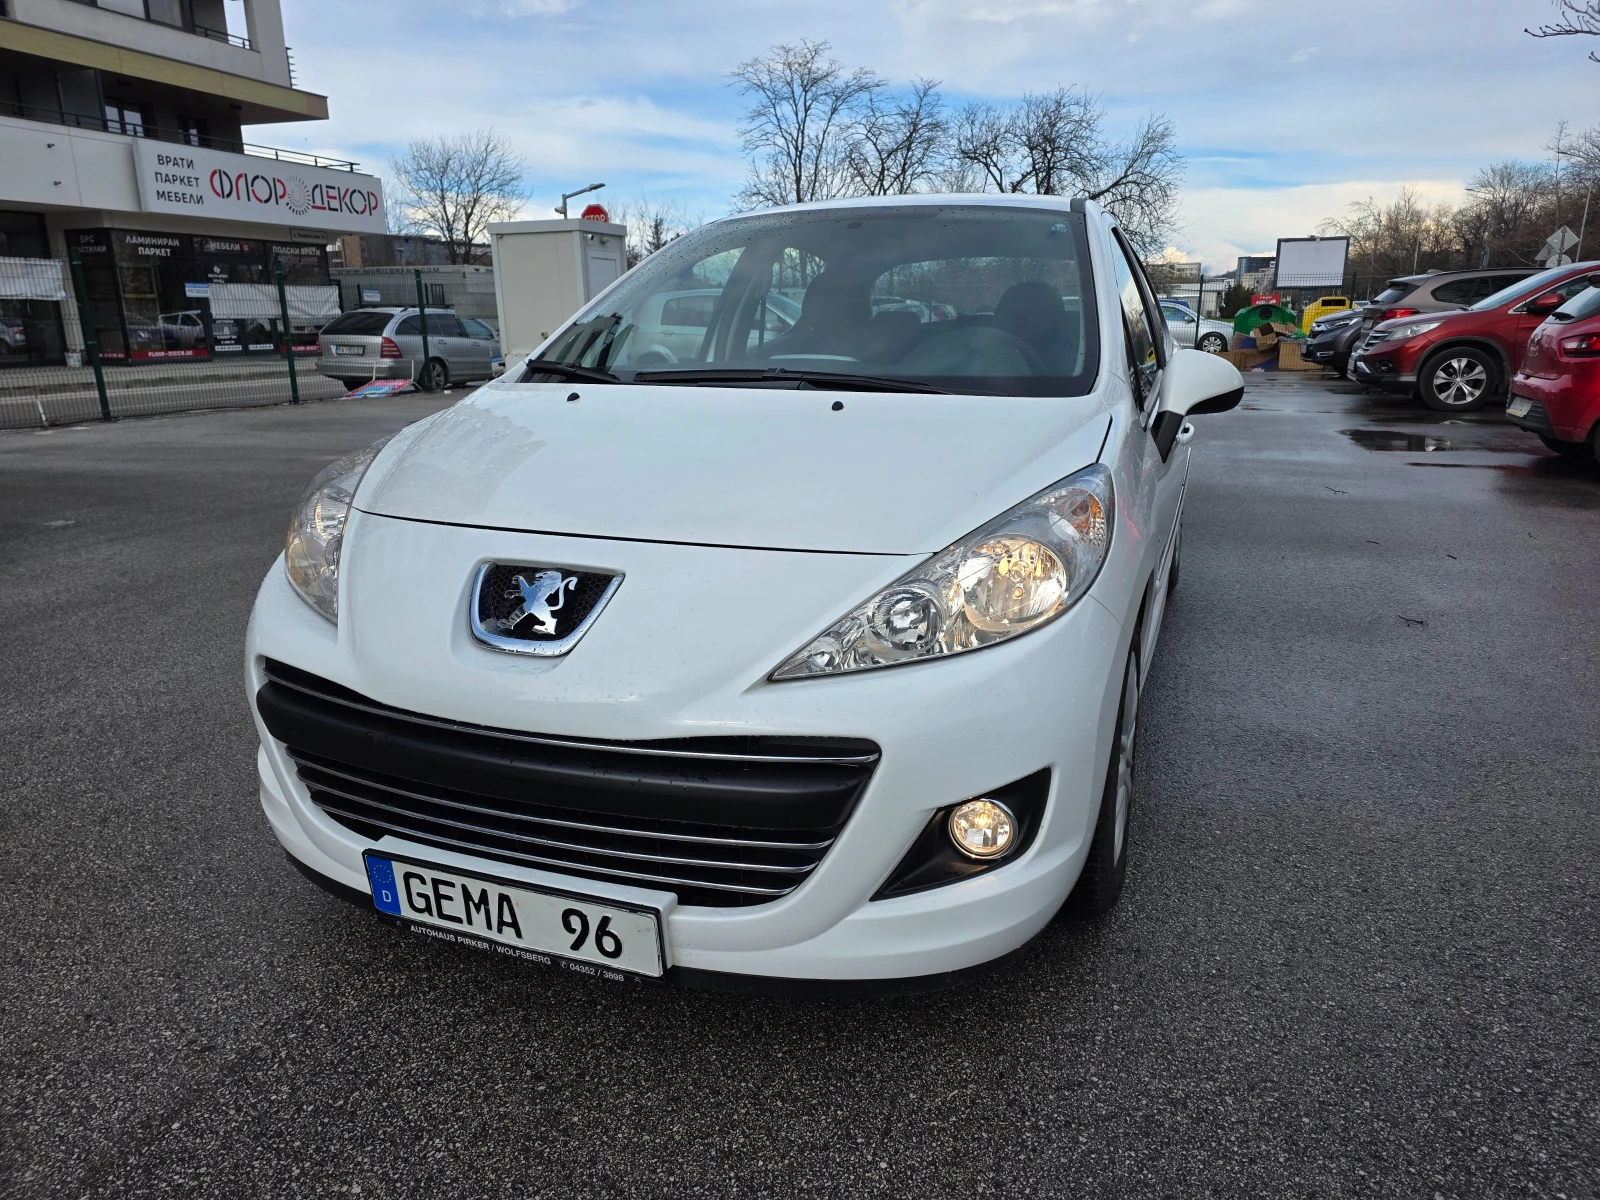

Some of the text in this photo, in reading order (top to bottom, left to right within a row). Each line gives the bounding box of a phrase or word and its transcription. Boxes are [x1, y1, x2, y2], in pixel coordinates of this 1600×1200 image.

[157, 154, 195, 170] ВРАТИ
[155, 172, 200, 188] ПАРКЕТ
[156, 190, 204, 205] МЕБЕЛИ
[210, 168, 378, 216] ФЛОР ДЕКОР
[80, 235, 95, 243] SPC
[126, 235, 180, 247] ЛАМИНИРАН
[138, 247, 171, 256] ПАРКЕТ
[272, 245, 320, 256] ПОЛСКИ ВРАТИ
[381, 890, 392, 903] D
[402, 871, 623, 959] GEMA 96
[410, 925, 456, 942] AUTOHAUS
[457, 936, 490, 951] PIRKER
[496, 946, 551, 965] WOLFSBERG
[569, 963, 596, 976] 04352
[603, 971, 625, 982] 3898
